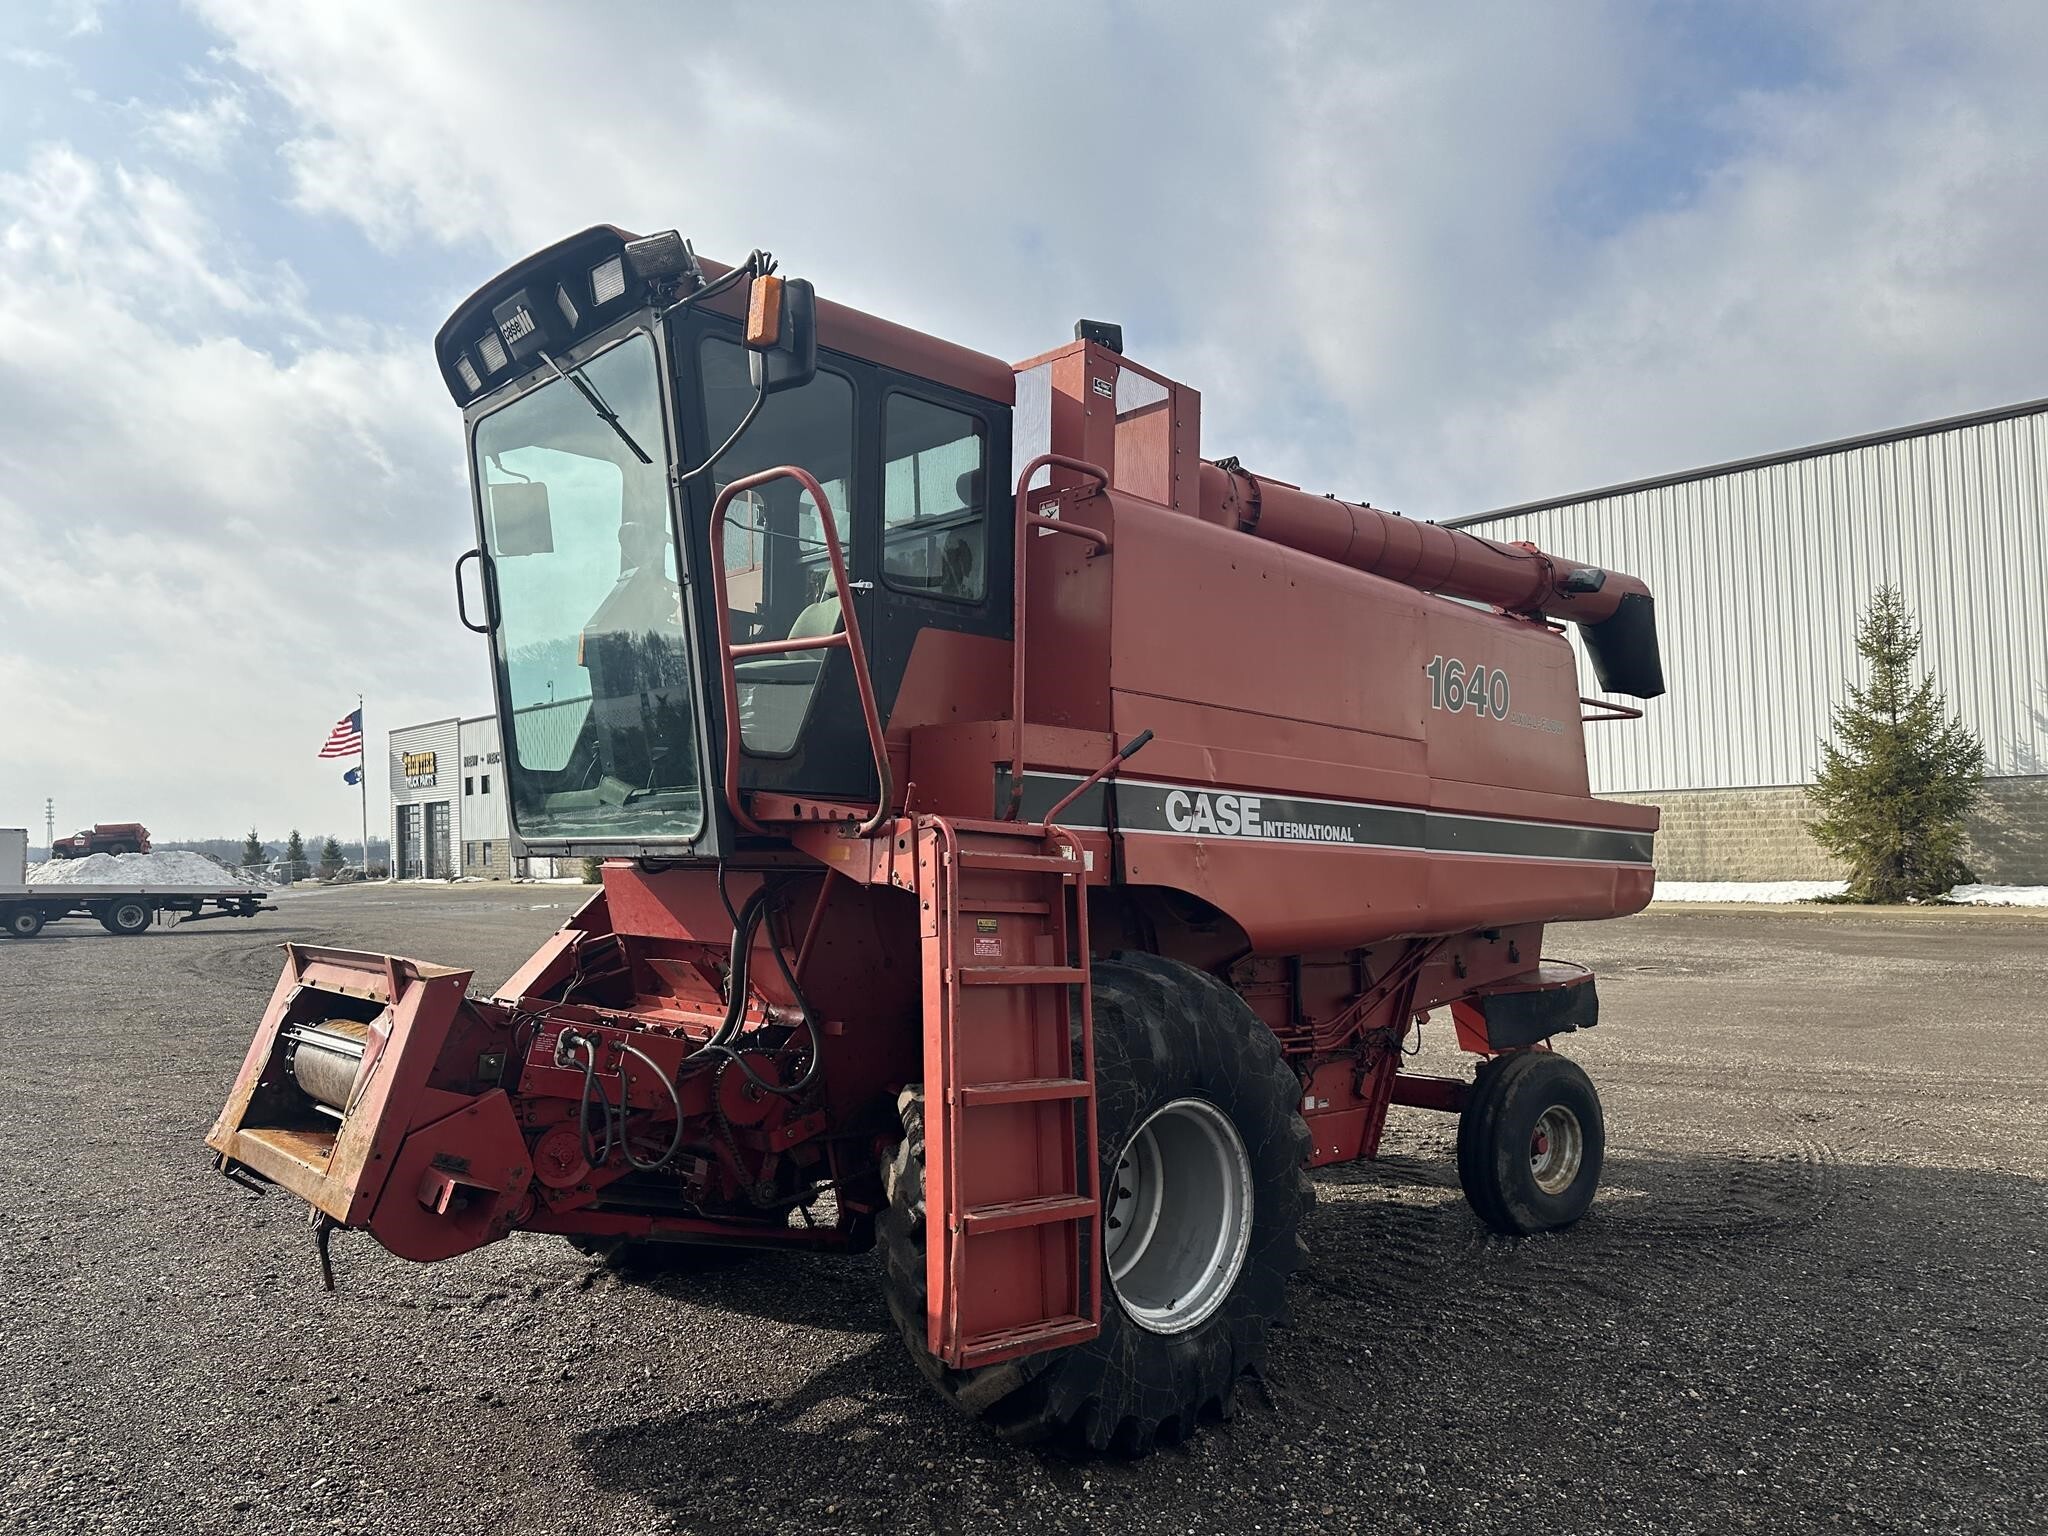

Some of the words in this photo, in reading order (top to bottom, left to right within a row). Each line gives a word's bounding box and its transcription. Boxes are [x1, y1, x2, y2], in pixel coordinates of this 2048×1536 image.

[1427, 655, 1510, 721] 1640
[464, 755, 478, 767] NEW
[1165, 790, 1261, 836] CASE
[1263, 820, 1354, 842] INTERNATIONAL
